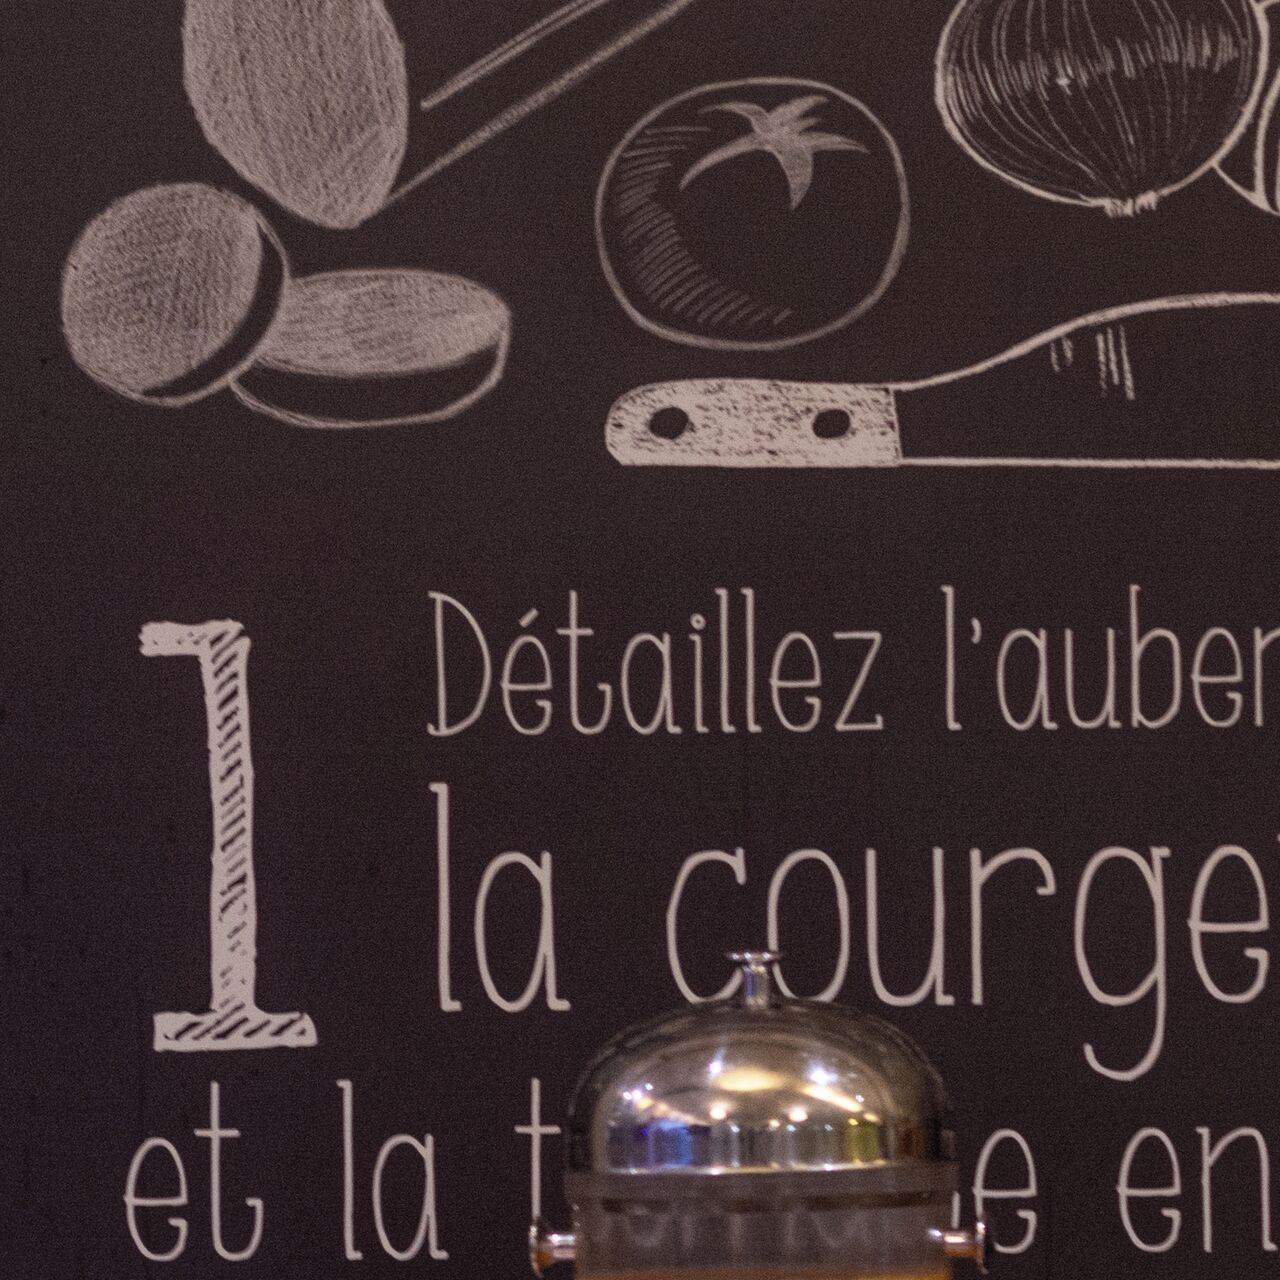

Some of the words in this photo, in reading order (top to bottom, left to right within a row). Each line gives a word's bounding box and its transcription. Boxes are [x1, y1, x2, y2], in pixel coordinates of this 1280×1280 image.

[427, 588, 883, 736] Détaillez
[942, 584, 1280, 730] l'auber
[139, 619, 318, 1052] 1
[429, 782, 570, 1012] la
[124, 1082, 263, 1261] et
[337, 1080, 448, 1260] la
[1117, 1127, 1278, 1253] en
